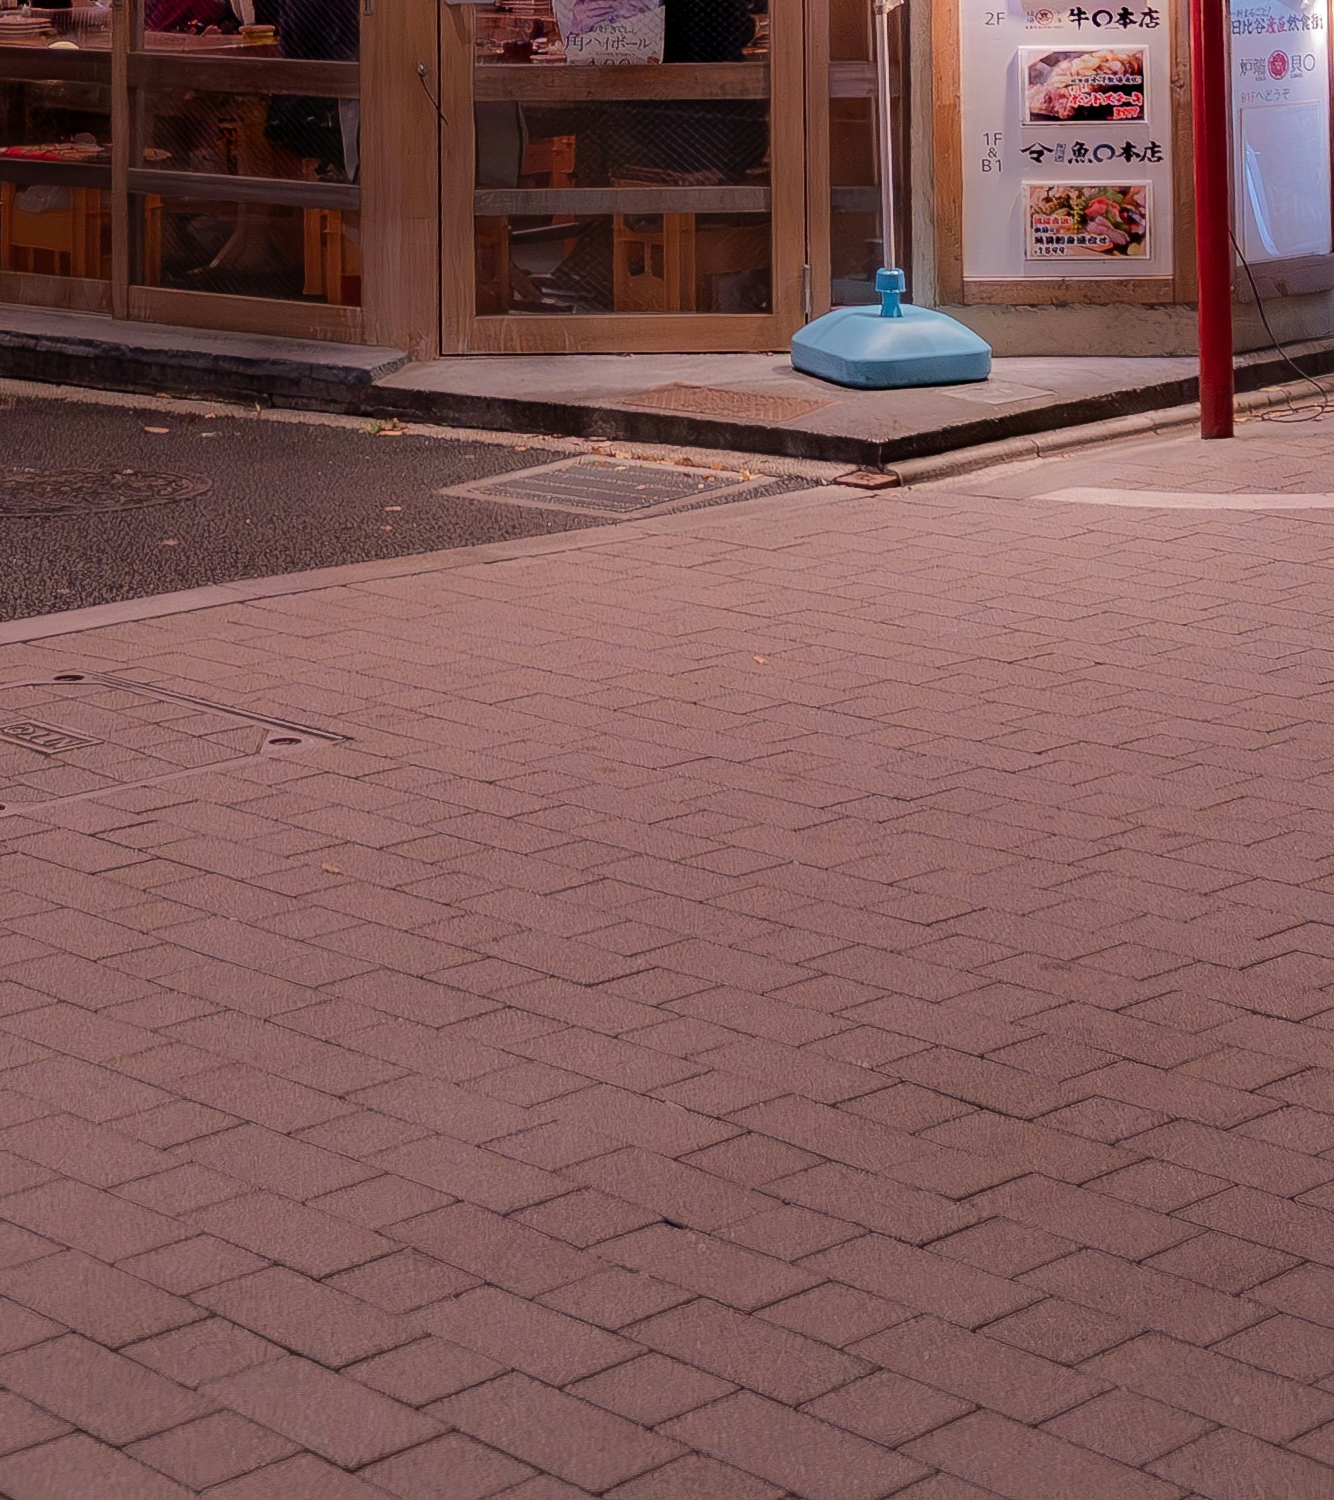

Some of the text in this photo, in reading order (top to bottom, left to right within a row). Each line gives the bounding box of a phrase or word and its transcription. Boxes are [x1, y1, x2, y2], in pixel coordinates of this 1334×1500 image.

[985, 12, 1005, 26] 2F
[567, 34, 651, 52] 角ハイボール
[982, 133, 1002, 146] 1F
[981, 159, 1002, 172] B1
